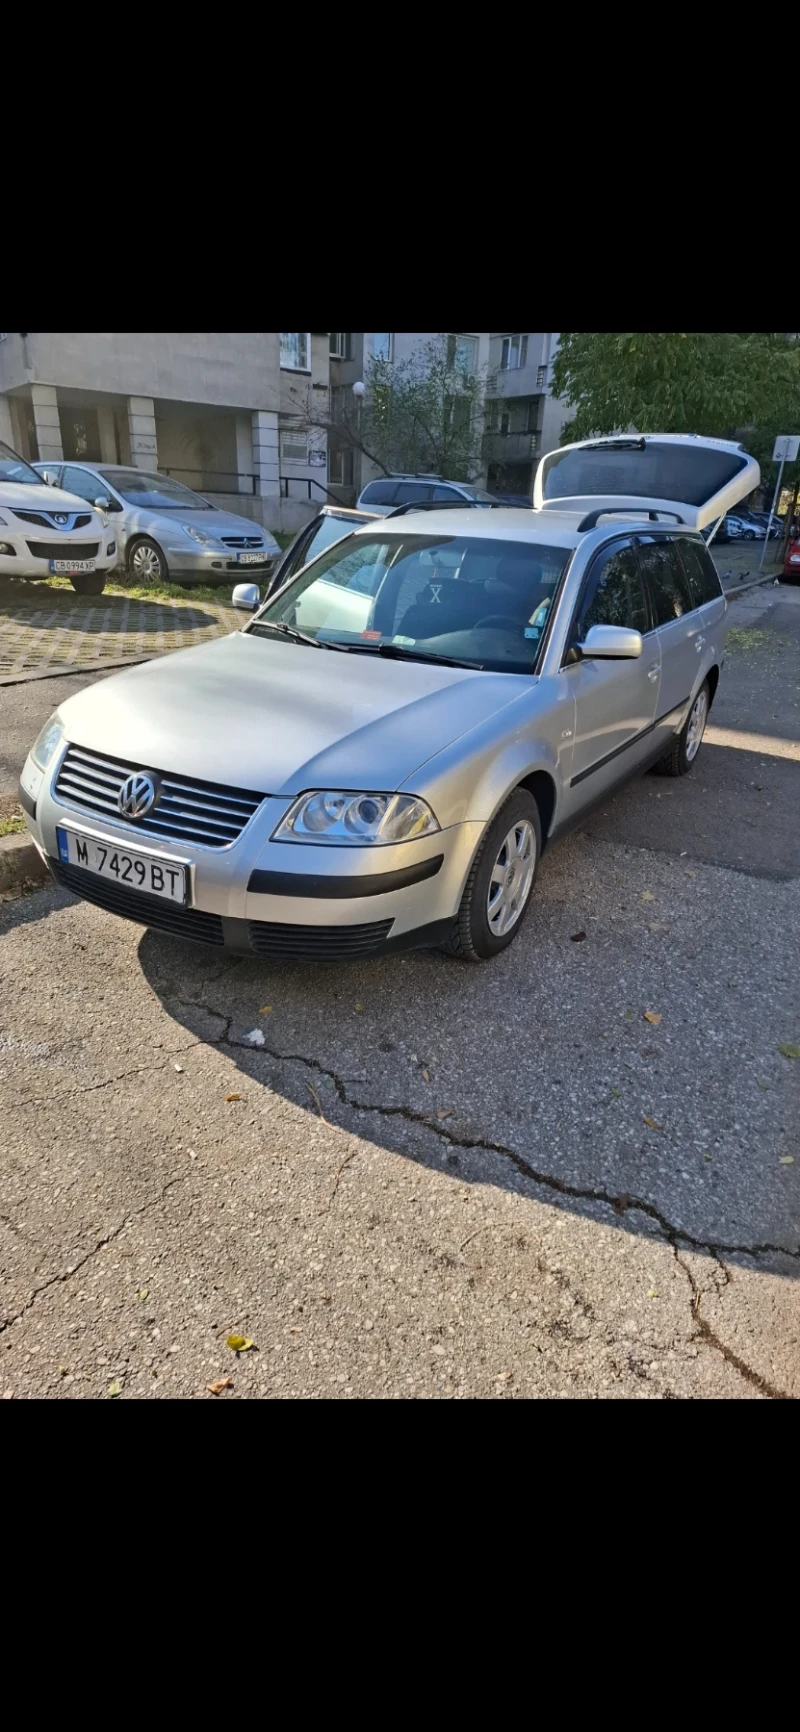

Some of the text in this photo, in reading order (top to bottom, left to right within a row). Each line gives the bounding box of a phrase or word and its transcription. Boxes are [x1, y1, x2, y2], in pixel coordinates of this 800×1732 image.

[66, 561, 84, 570] 0994
[76, 839, 180, 896] M 7429 BT
